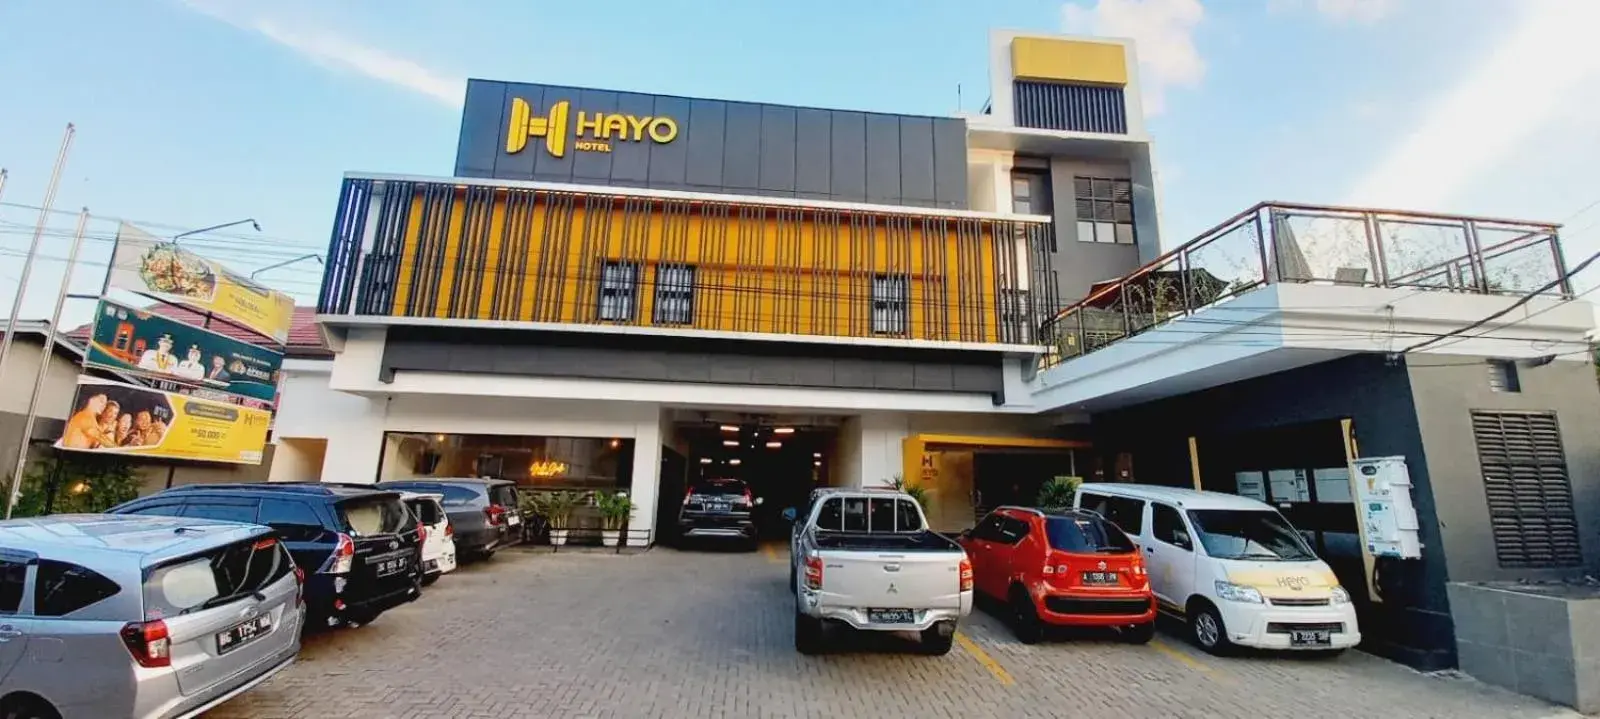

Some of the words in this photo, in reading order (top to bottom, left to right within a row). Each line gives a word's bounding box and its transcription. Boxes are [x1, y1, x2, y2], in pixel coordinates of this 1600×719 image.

[575, 110, 678, 144] HAYO
[575, 141, 612, 153] HOTEL
[1276, 575, 1311, 588] HAYO
[218, 631, 233, 646] BG
[238, 620, 258, 638] 1754
